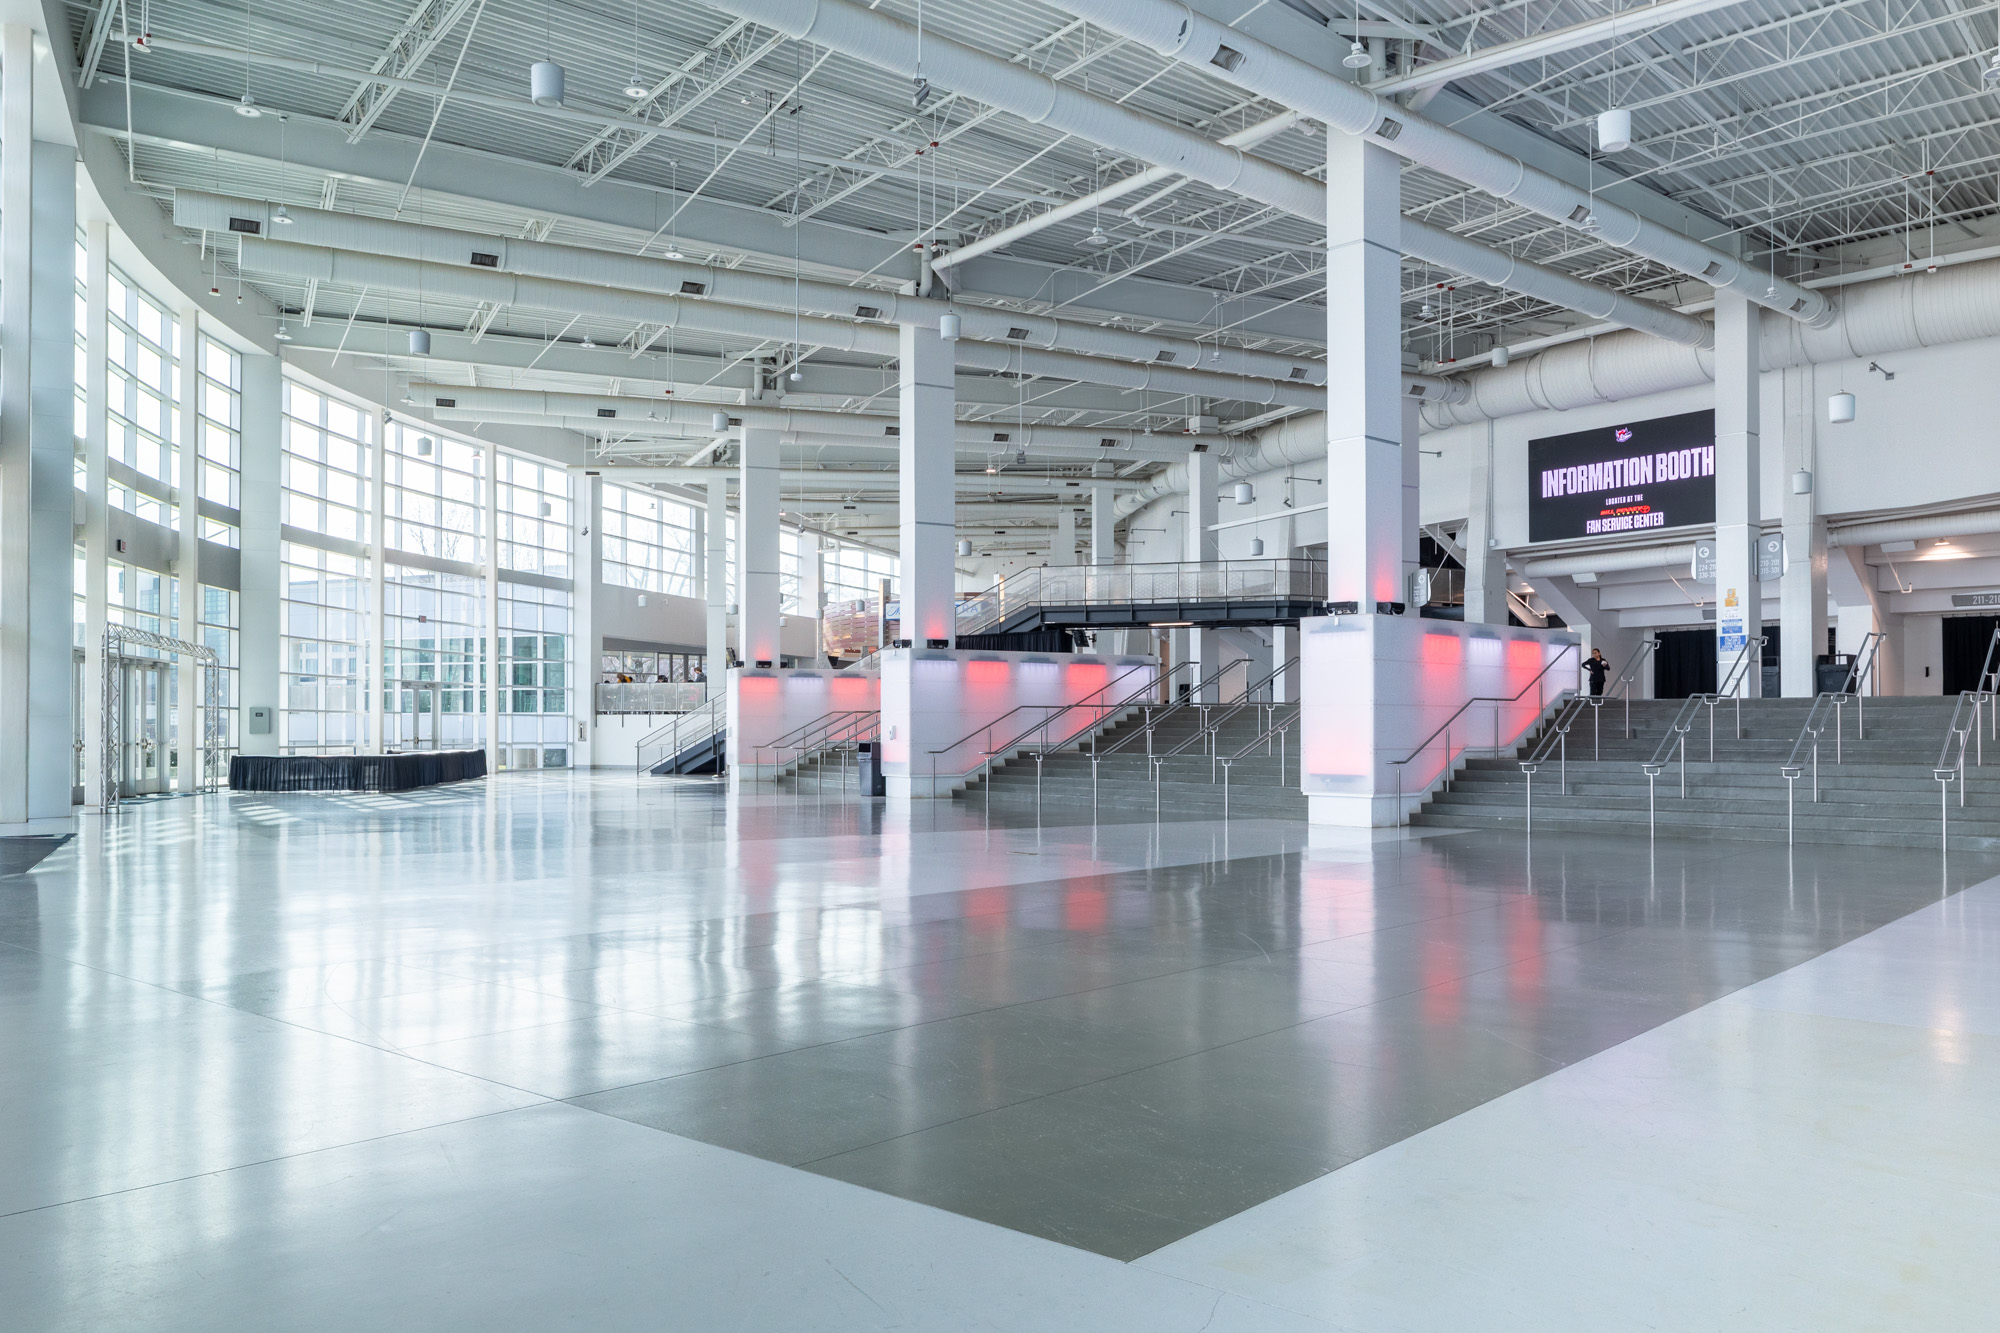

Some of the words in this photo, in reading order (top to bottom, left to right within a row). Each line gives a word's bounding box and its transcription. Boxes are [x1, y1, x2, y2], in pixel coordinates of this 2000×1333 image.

[1541, 454, 1653, 499] INFORMATION
[1655, 445, 1715, 483] BOOTH
[1605, 496, 1626, 506] LOCATED
[1627, 495, 1633, 503] AT
[1634, 493, 1644, 502] THE
[1586, 519, 1602, 534] FAN
[1602, 515, 1633, 532] SERVICE
[1634, 511, 1664, 529] CENTER
